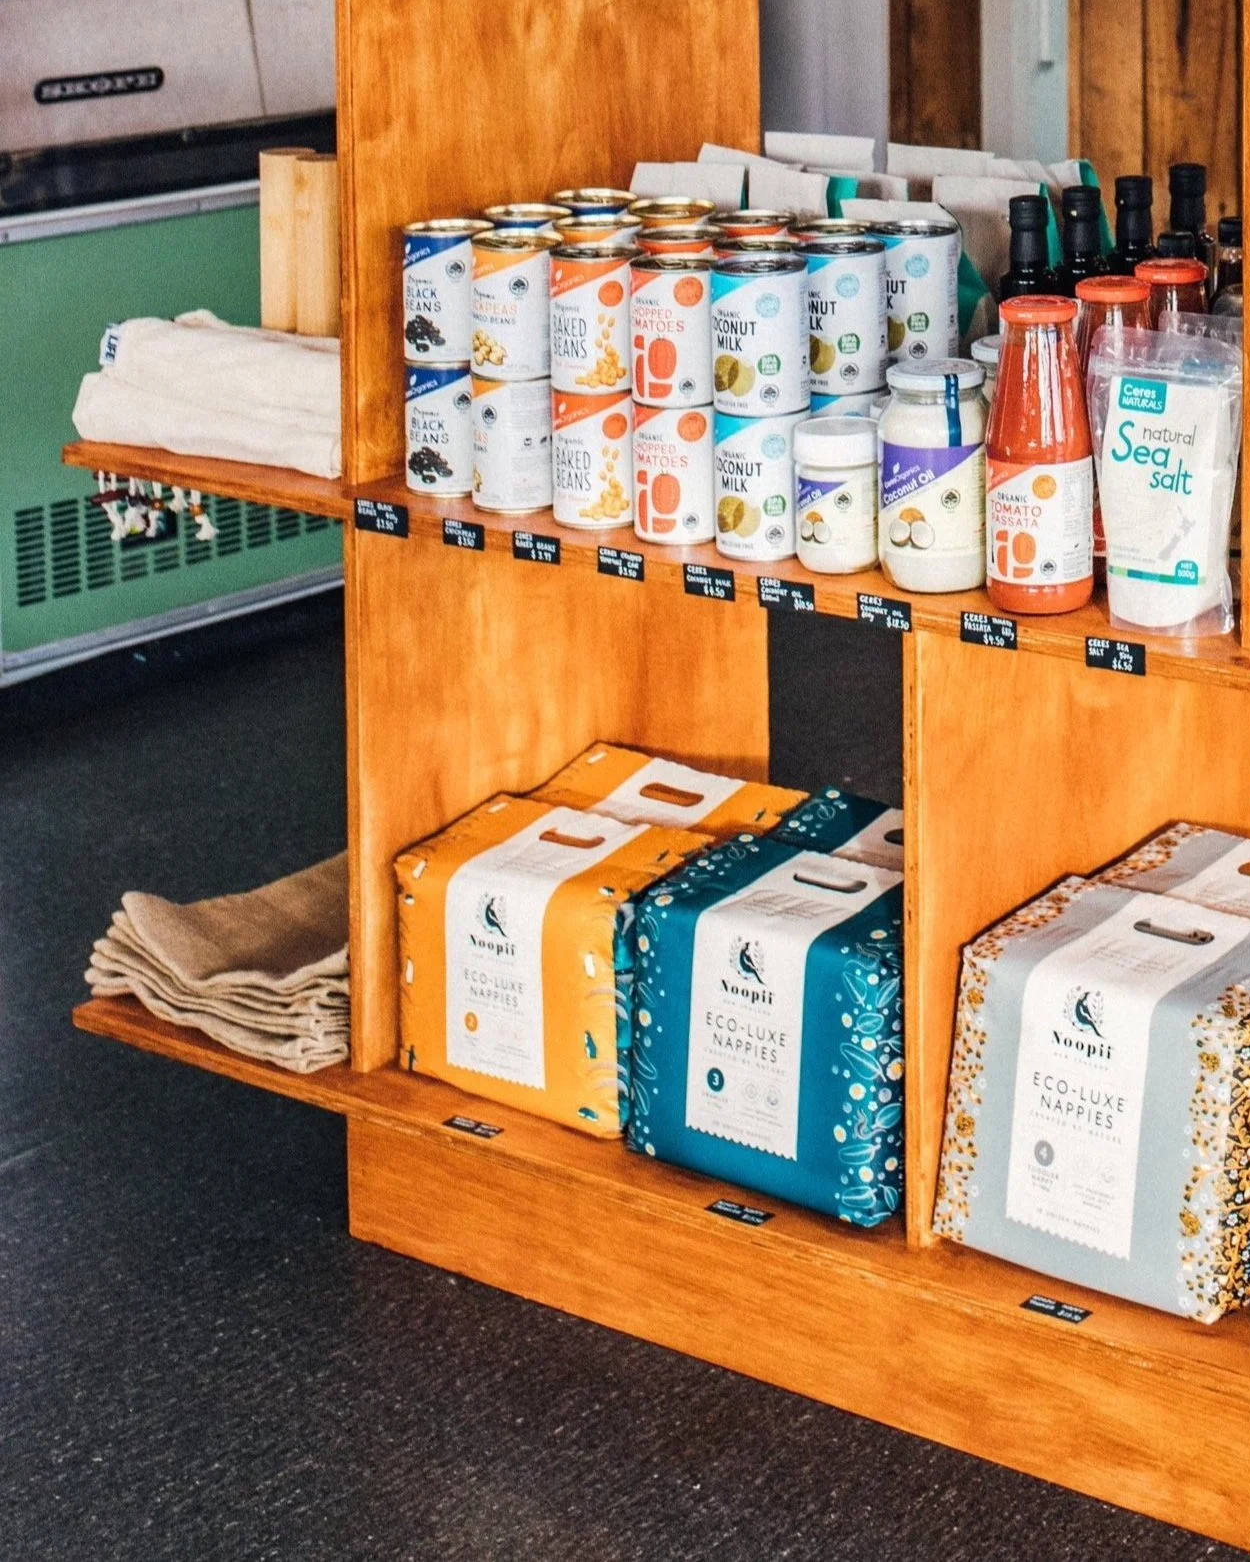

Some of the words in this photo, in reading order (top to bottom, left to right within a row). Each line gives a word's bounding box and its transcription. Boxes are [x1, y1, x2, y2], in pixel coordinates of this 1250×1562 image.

[406, 286, 437, 299] BLACK
[406, 299, 441, 313] BEANS
[553, 315, 587, 337] BAKED
[553, 338, 588, 359] BEANS
[717, 336, 743, 352] MILK
[1123, 384, 1157, 399] Ceres
[1122, 397, 1163, 410] NATURALS
[1111, 420, 1170, 468] Sea
[1142, 424, 1197, 447] natural
[884, 478, 919, 504] Coconut
[920, 468, 934, 486] Oil
[1149, 459, 1193, 495] salt
[991, 499, 1042, 517] TOMATO
[997, 492, 1028, 503] ORGANIC
[991, 514, 1039, 528] PASSATA
[1088, 640, 1110, 649] CERES
[1117, 643, 1129, 651] SEA
[1089, 647, 1104, 656] SALT
[1112, 657, 1132, 672] $6.50
[469, 933, 516, 957] Noopii
[464, 968, 525, 996] ECO-LUXE
[721, 978, 775, 1007] Noopii
[469, 985, 520, 1010] NAPPIES
[706, 1011, 788, 1048] ECO-LUXE
[712, 1032, 779, 1065] NAPPIES
[1052, 1030, 1114, 1061] Noopii
[712, 1072, 720, 1086] 3
[1033, 1071, 1126, 1112] ECO-LUXE
[1040, 1095, 1114, 1130] NAPPIES
[1039, 1145, 1048, 1159] 4
